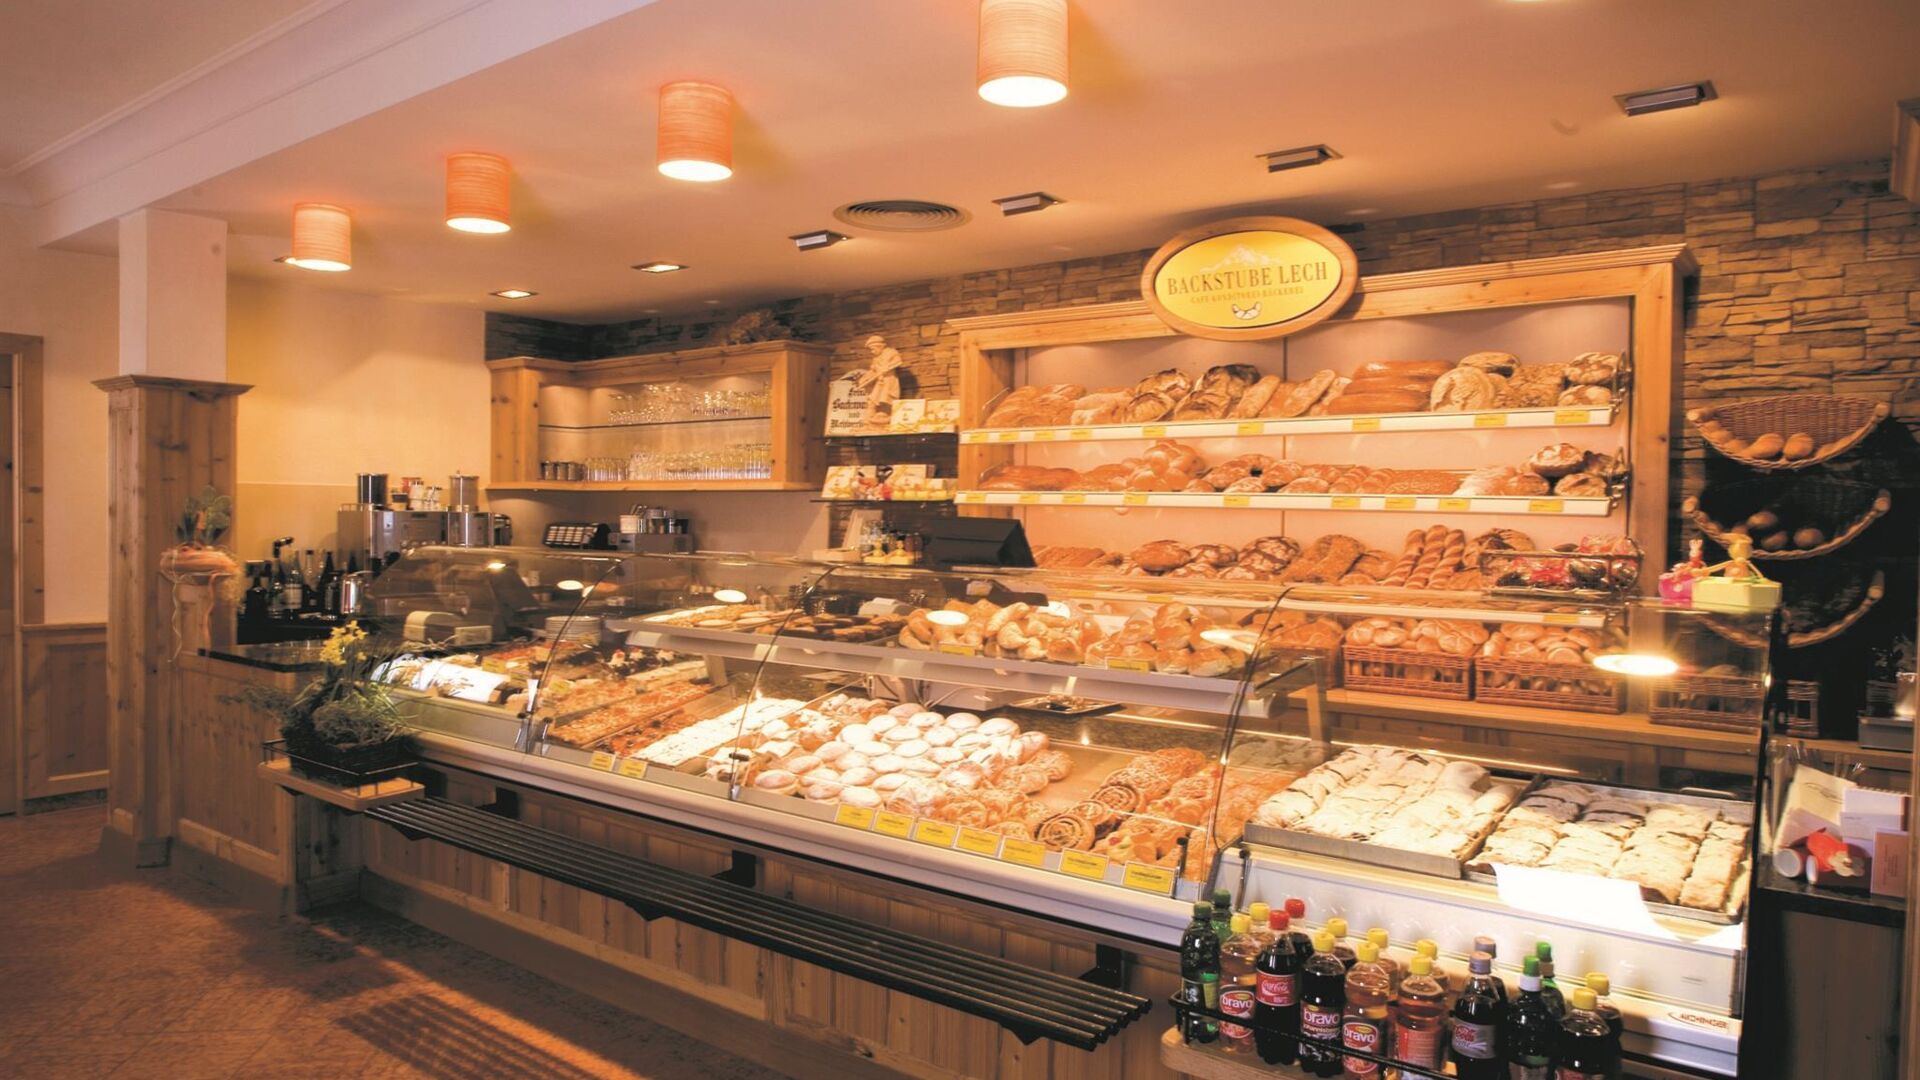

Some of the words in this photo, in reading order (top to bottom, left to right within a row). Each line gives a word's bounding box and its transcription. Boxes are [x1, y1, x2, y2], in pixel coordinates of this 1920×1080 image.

[1167, 266, 1272, 296] BACKSTUBE
[1279, 261, 1328, 285] LECH
[1222, 996, 1253, 1009] bravo
[1303, 1007, 1340, 1025] bravo
[1343, 1026, 1376, 1043] bravo
